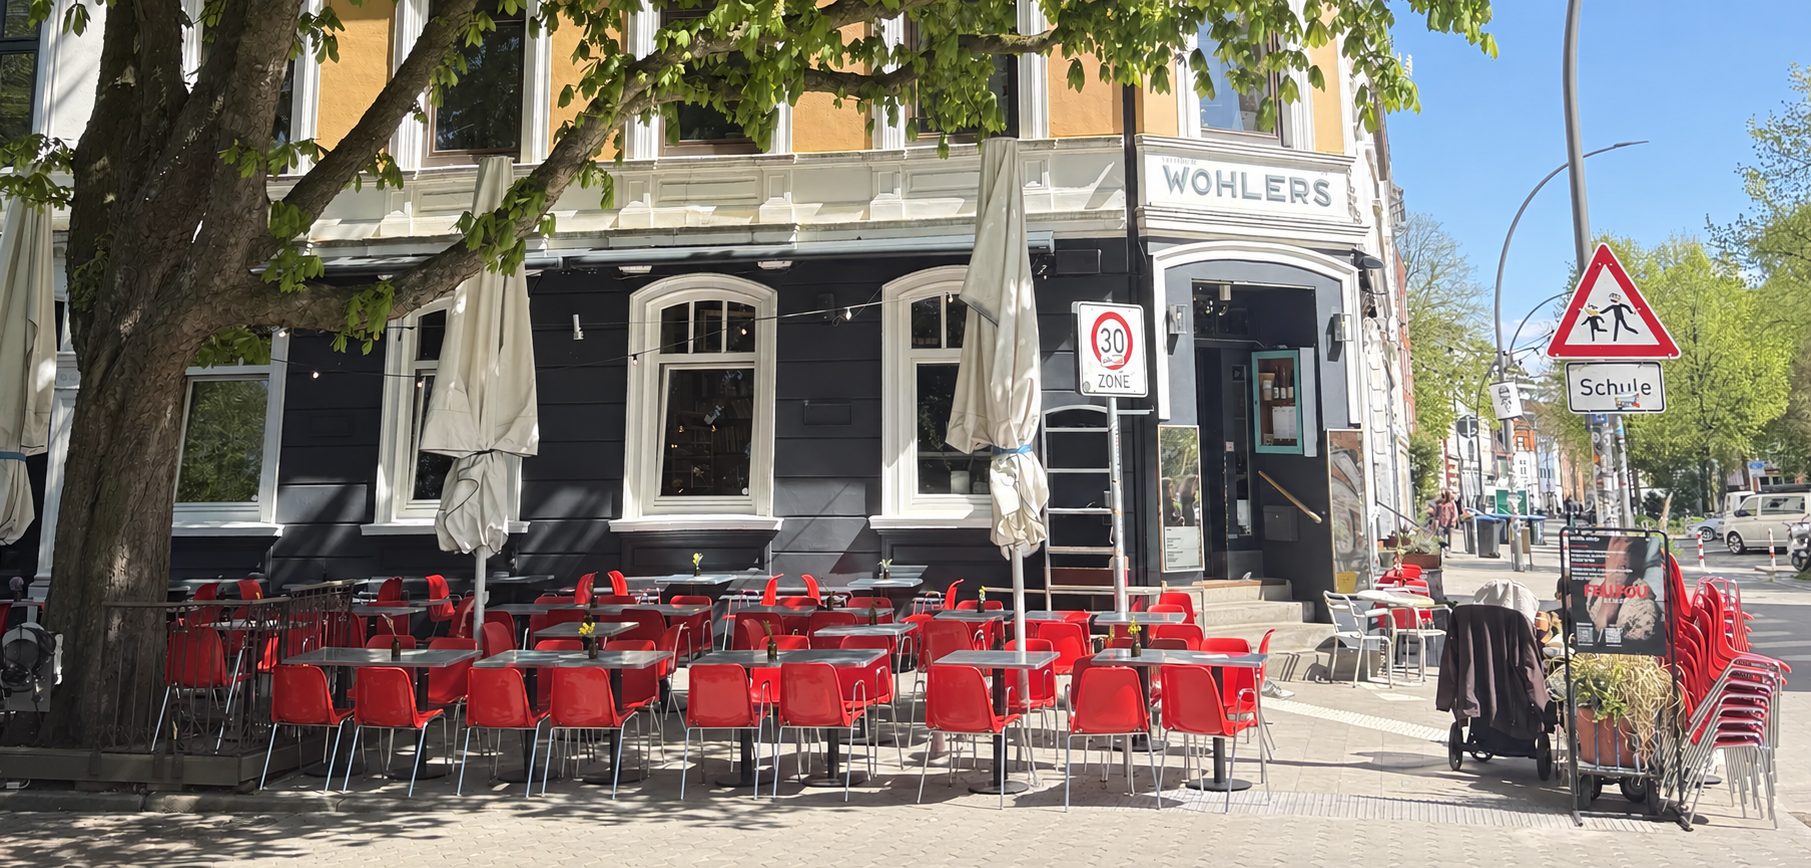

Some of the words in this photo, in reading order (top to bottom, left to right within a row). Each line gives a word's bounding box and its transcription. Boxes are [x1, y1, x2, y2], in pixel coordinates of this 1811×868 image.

[1162, 165, 1332, 207] WOHLERS
[1100, 327, 1125, 354] 30
[1098, 374, 1130, 389] ZONE
[1580, 378, 1652, 396] Schule
